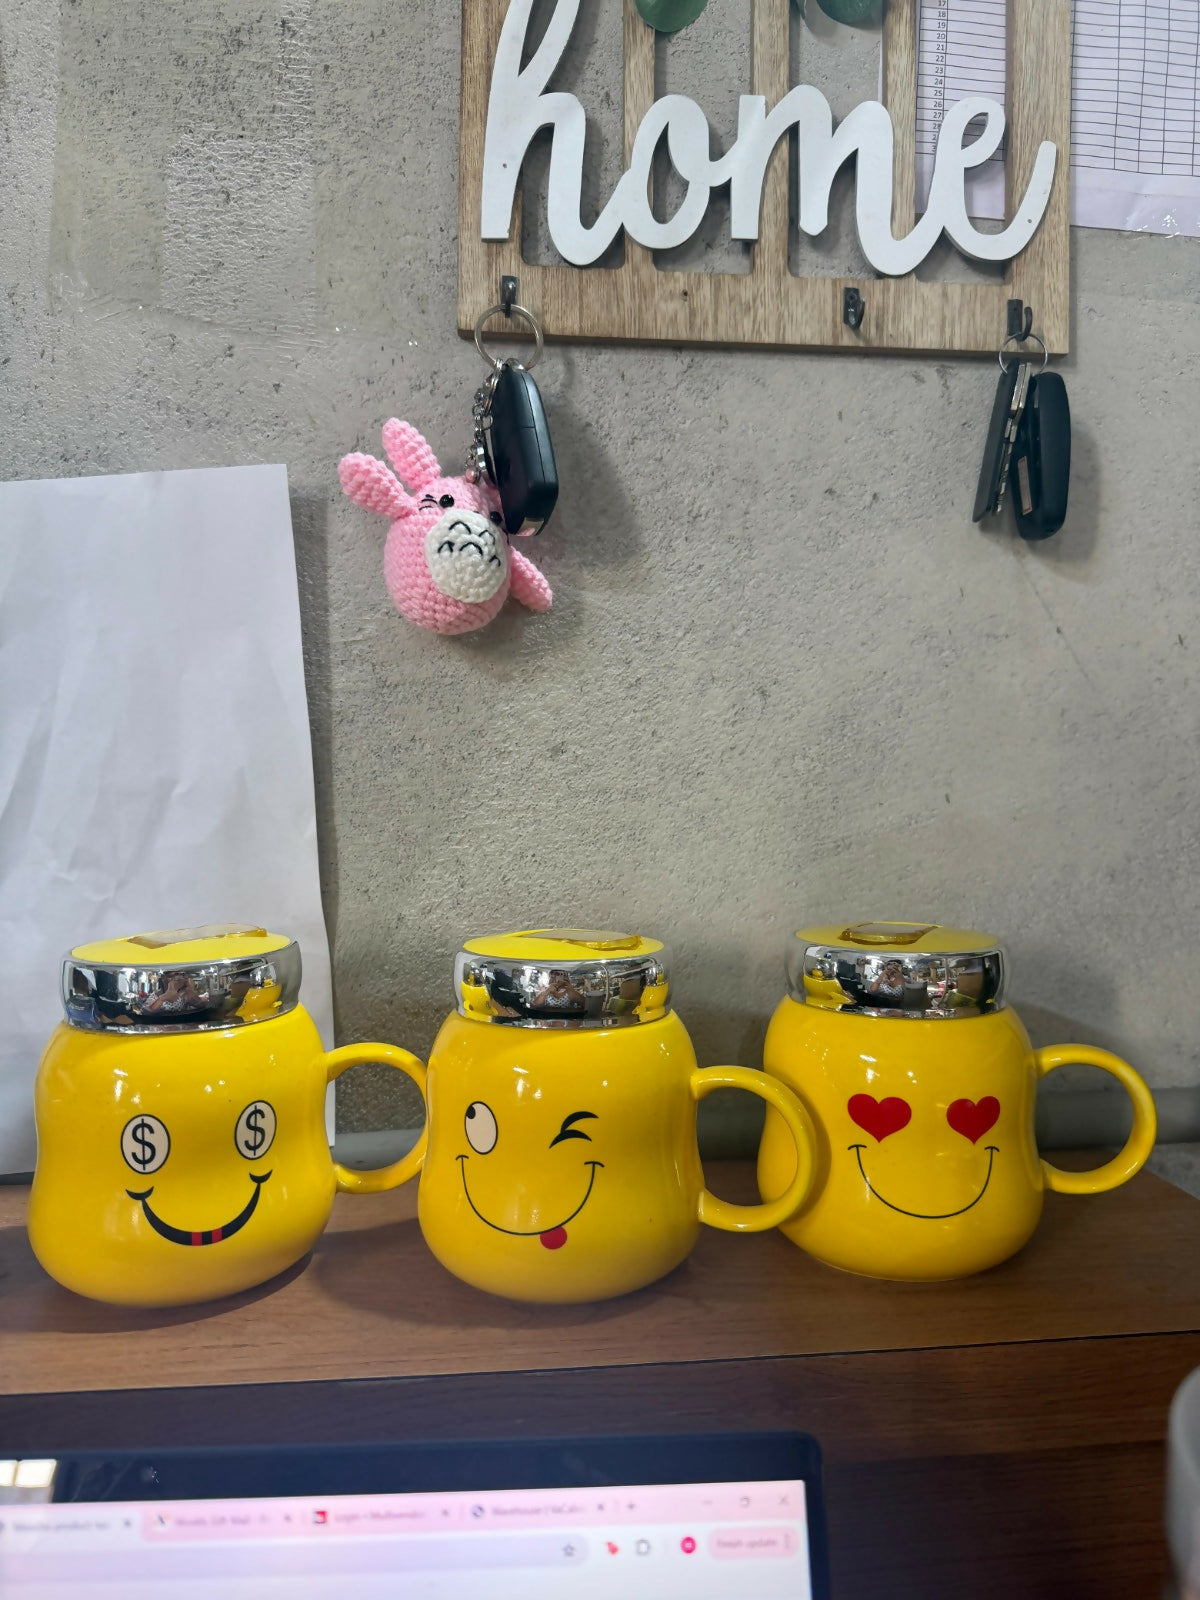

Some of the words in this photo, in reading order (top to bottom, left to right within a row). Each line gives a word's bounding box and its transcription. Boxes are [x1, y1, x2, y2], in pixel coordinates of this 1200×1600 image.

[938, 10, 946, 18] 18
[937, 21, 946, 29] 19
[936, 32, 946, 40] 20
[936, 43, 945, 51] 21
[935, 54, 945, 63] 22
[935, 66, 944, 74] 23
[934, 77, 943, 85] 24
[933, 89, 943, 97] 25
[933, 100, 943, 108] 26
[933, 111, 942, 120] 27
[480, 0, 1057, 276] home
